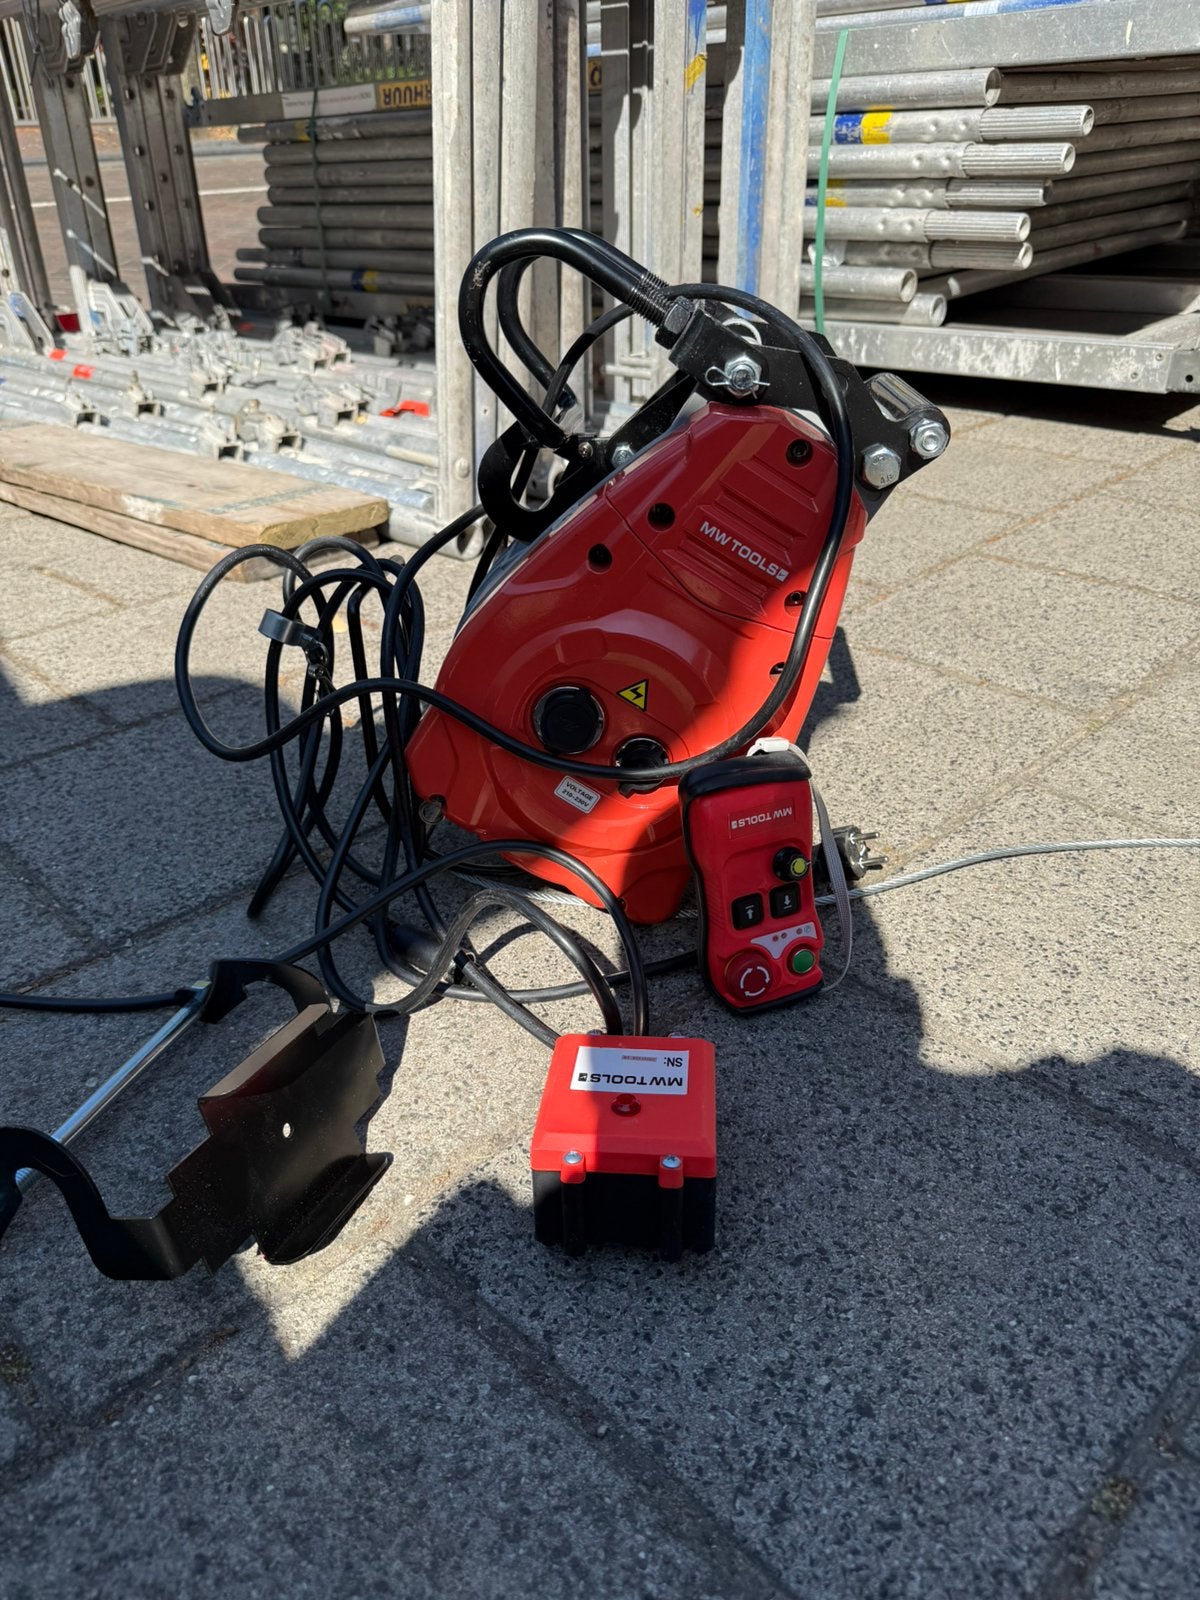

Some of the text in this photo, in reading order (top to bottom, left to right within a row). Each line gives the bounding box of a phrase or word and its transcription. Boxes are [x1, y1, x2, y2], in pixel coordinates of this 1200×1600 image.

[699, 521, 779, 576] MW TOOLS
[566, 781, 594, 801] VOLTAGE
[738, 807, 793, 828] MW TOOLS
[663, 1057, 683, 1068] SN:
[590, 1073, 683, 1087] MW TOOLS
